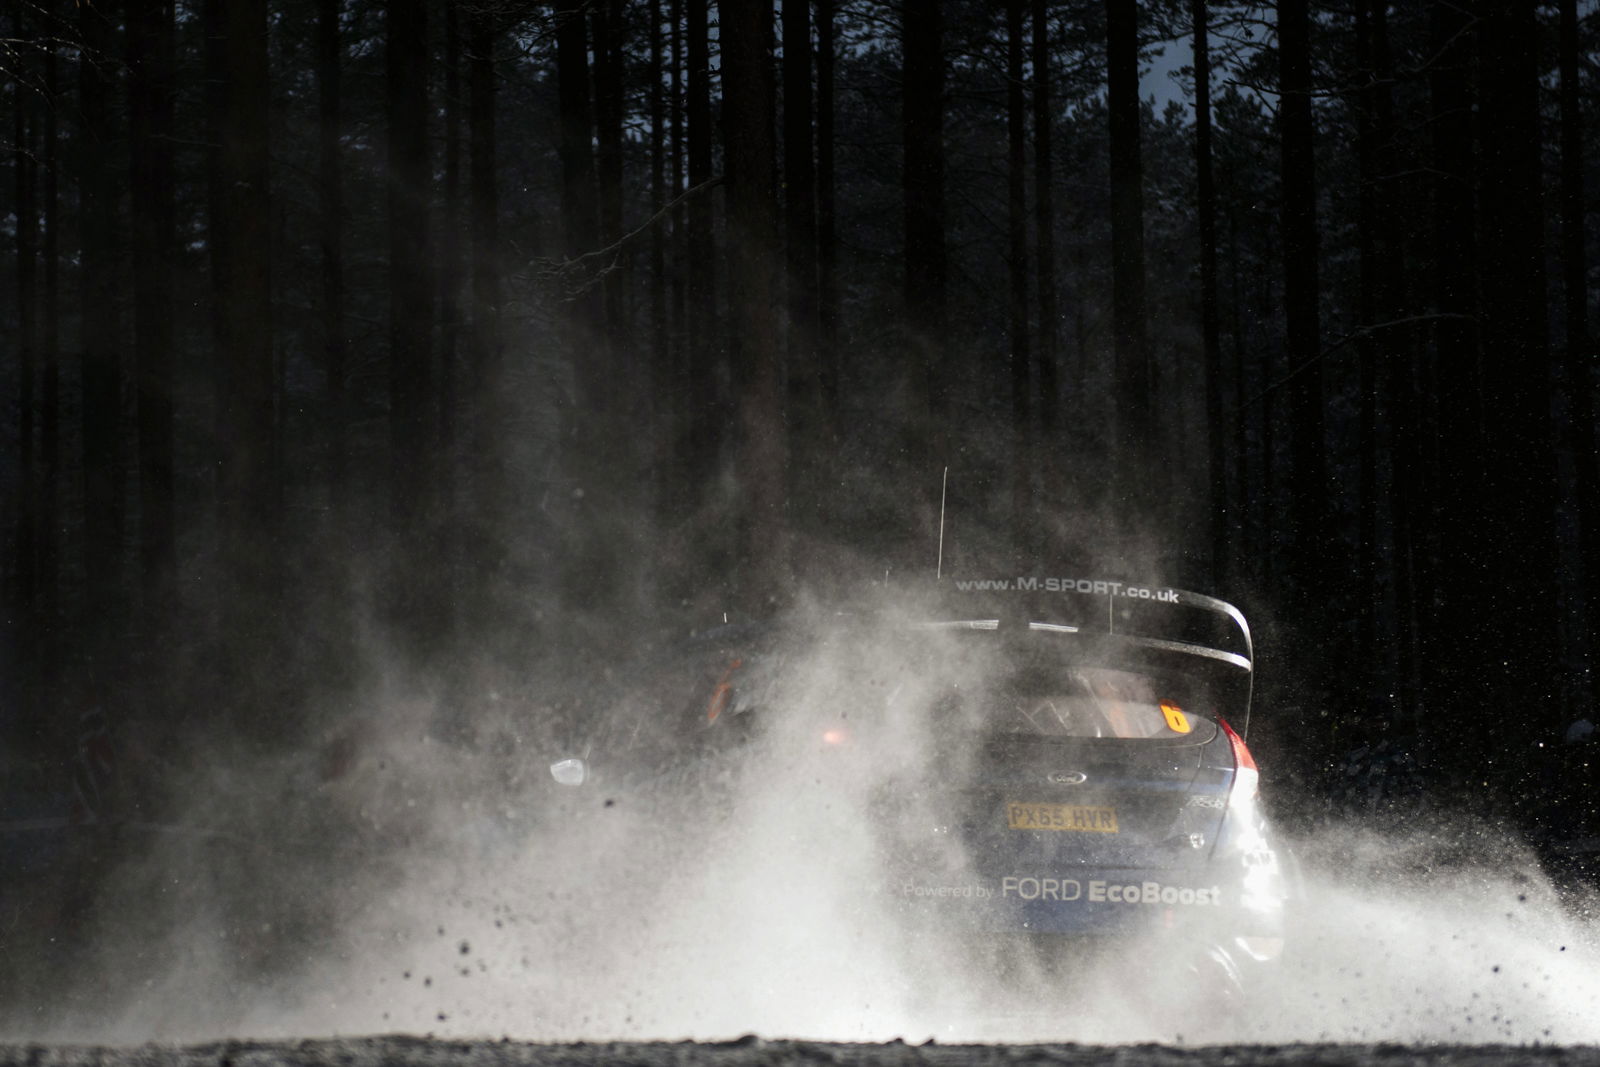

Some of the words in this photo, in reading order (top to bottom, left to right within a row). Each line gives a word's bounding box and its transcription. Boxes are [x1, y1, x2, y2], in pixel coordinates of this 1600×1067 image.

[956, 577, 1180, 604] www.M-SPORT.co.uk
[1159, 702, 1191, 734] 6
[1010, 806, 1065, 826] PX65
[1072, 808, 1113, 828] HVR
[903, 882, 972, 899] Powered
[976, 884, 995, 900] by
[1002, 876, 1081, 901] FORD
[1088, 880, 1222, 907] EcoBoost
